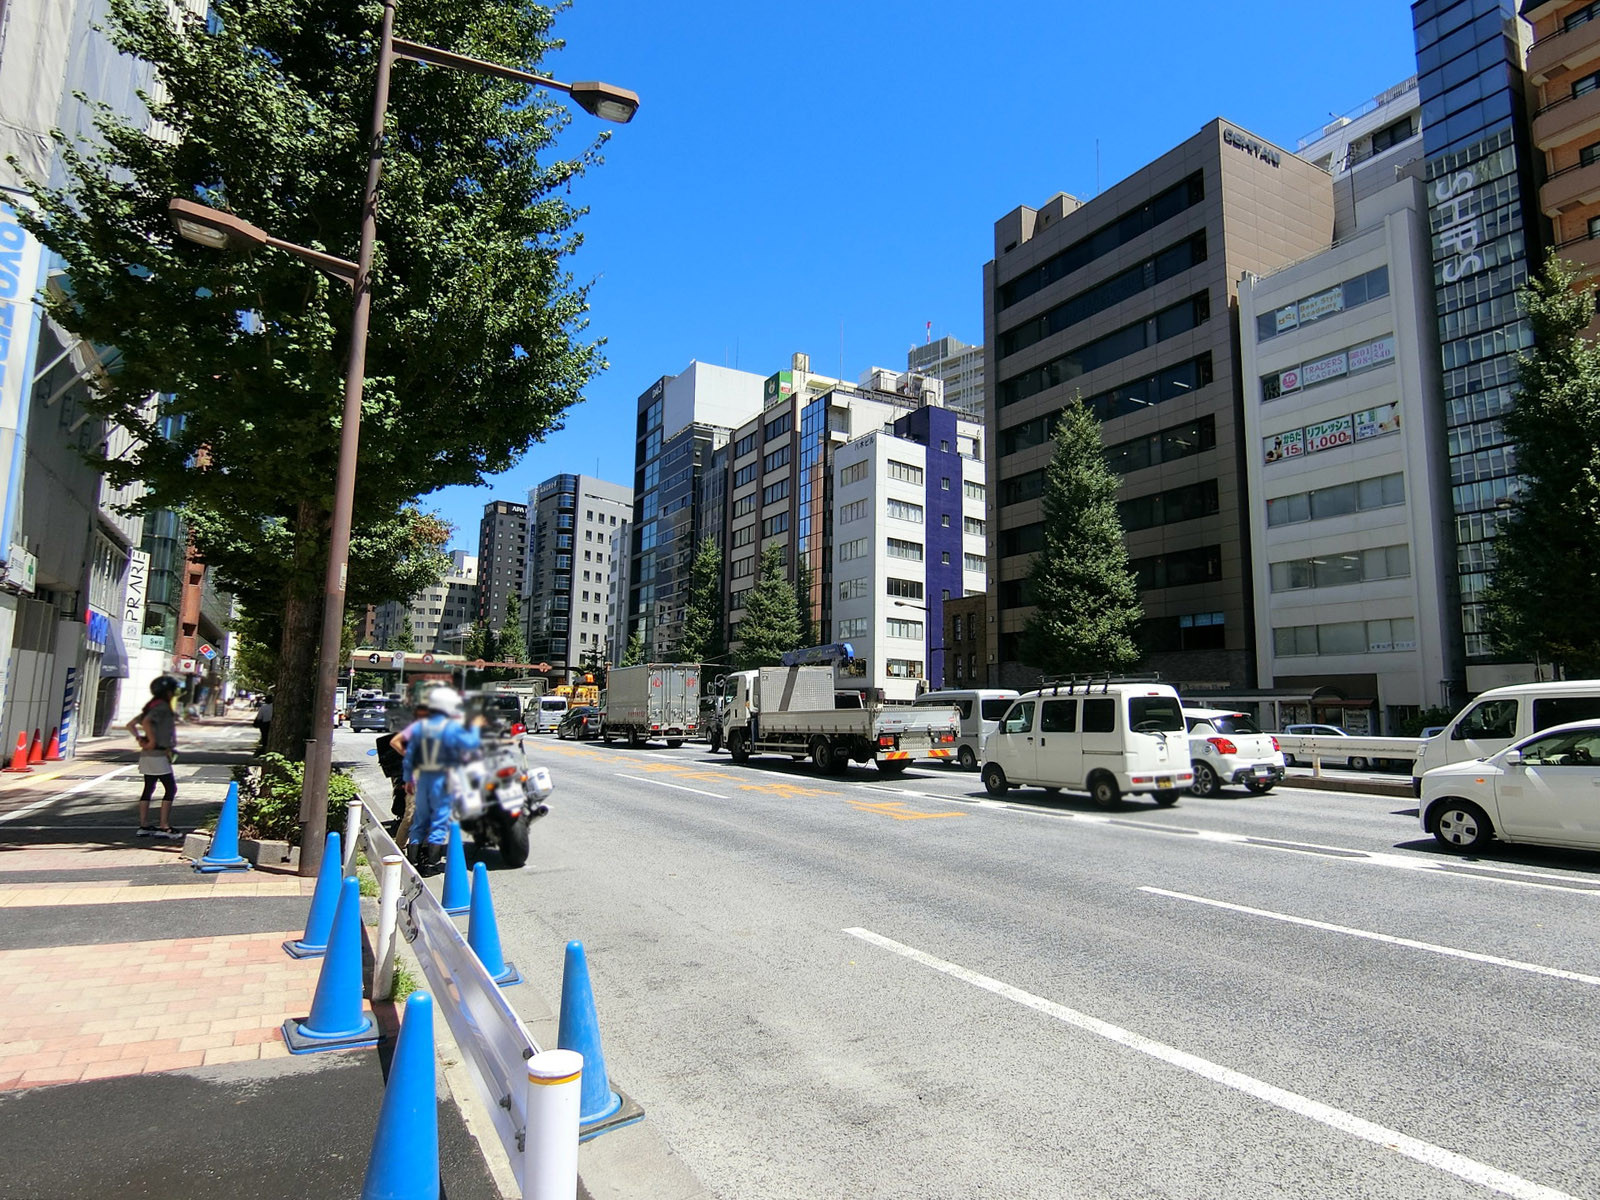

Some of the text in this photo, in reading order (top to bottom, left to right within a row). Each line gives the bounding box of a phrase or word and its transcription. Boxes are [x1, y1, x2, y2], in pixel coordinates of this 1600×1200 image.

[1435, 171, 1482, 282] SHIPS
[1304, 356, 1343, 375] TRADERS
[1304, 367, 1343, 383] ACADEMY
[1307, 420, 1351, 438] リフレッシュ
[511, 505, 525, 514] APA
